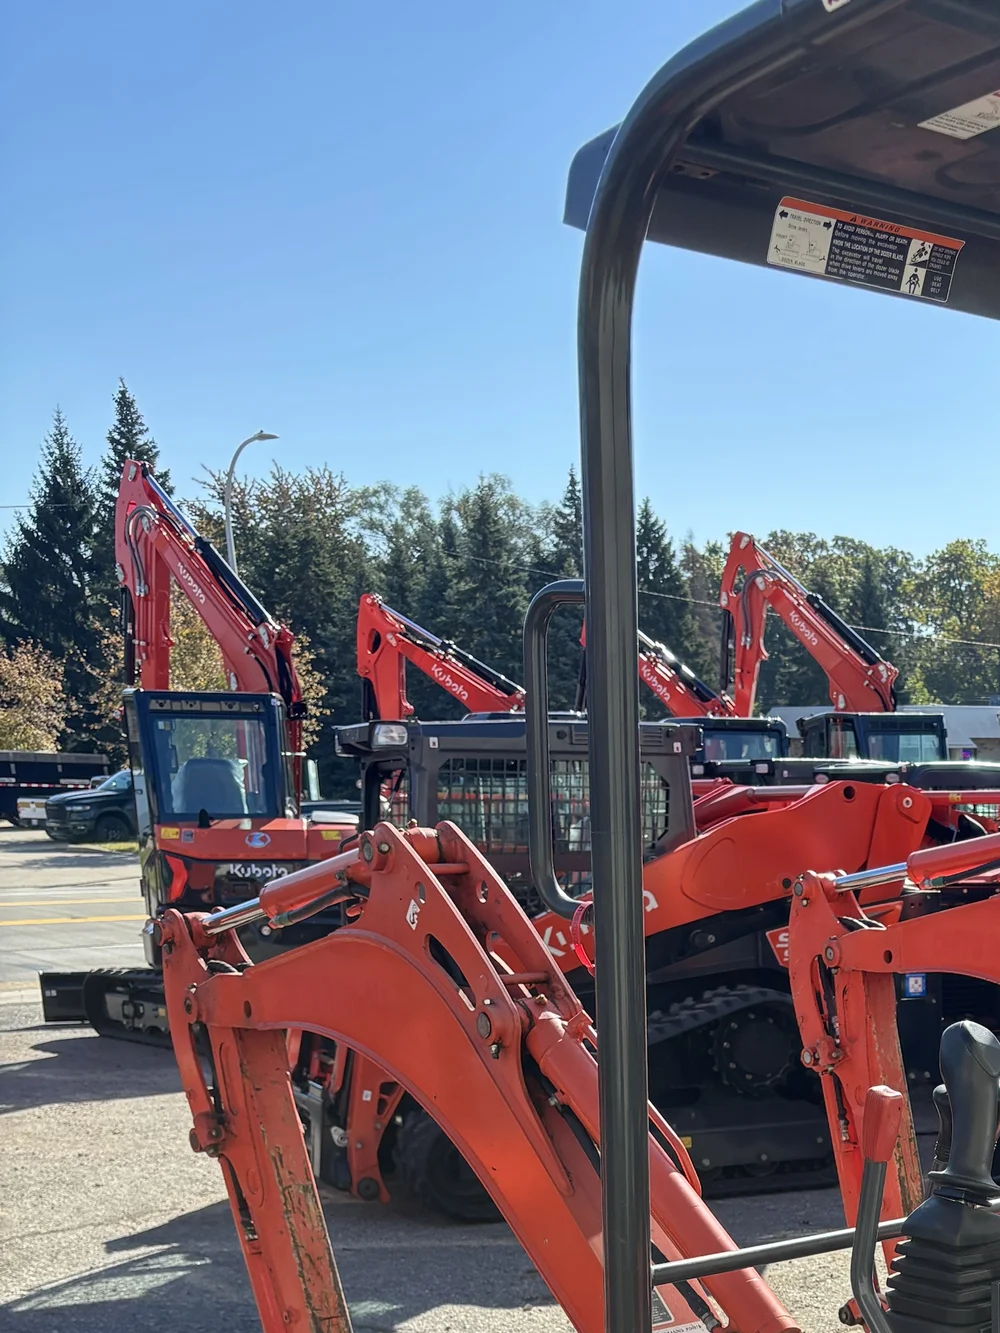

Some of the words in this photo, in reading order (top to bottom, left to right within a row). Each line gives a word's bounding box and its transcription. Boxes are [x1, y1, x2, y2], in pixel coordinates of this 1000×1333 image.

[860, 218, 900, 233] WARNING
[176, 561, 206, 604] Kubota
[789, 610, 819, 646] Kubota
[430, 663, 469, 701] Kubota
[641, 664, 671, 701] Kubota
[229, 863, 288, 878] Kubota
